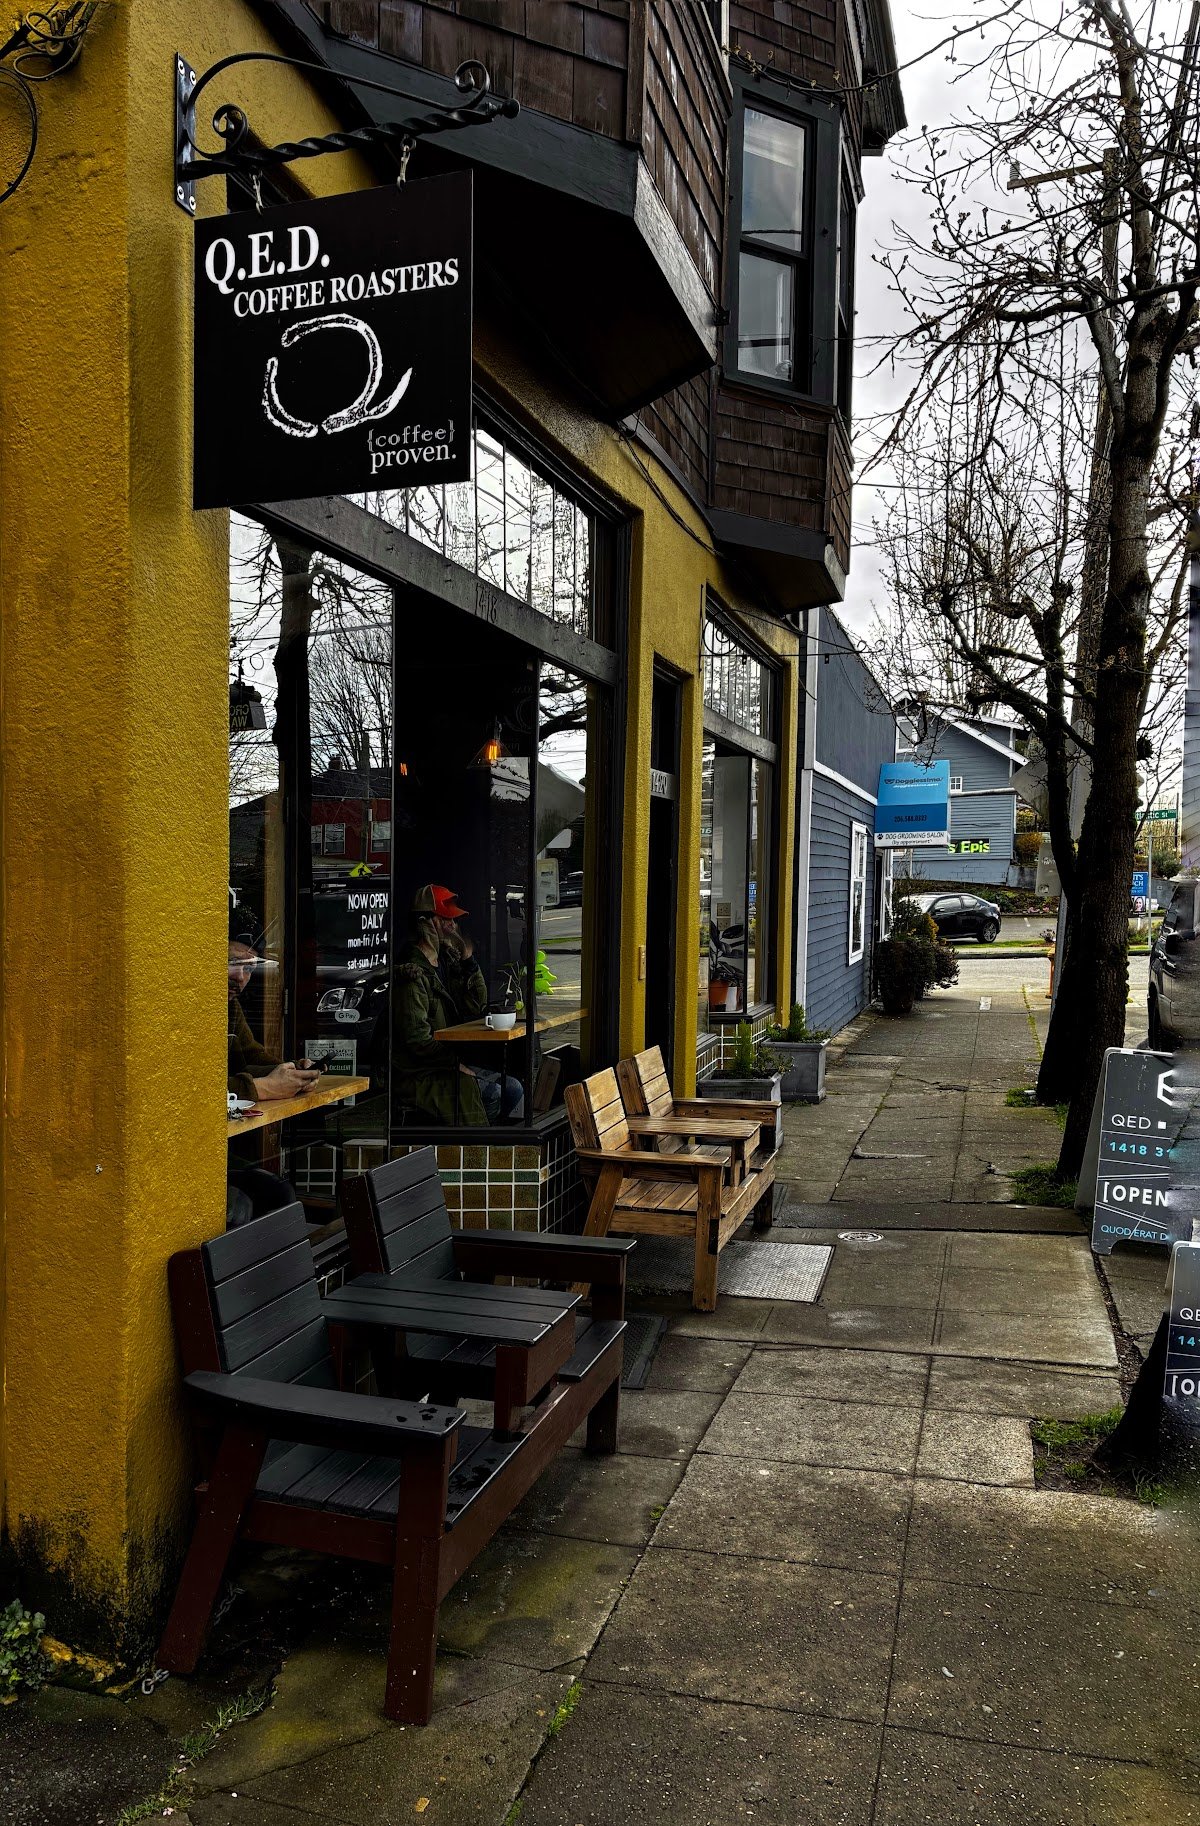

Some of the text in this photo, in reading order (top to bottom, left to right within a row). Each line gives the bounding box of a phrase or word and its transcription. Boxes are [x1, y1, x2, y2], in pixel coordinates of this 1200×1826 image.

[205, 225, 330, 295] Q.E.D.
[233, 258, 459, 317] COFFEE ROASTERS
[370, 444, 457, 475] proven.
[475, 583, 497, 623] 1418
[348, 893, 388, 910] NOW OPEN
[361, 913, 384, 930] DAILY
[347, 933, 371, 948] mon-fri
[347, 957, 369, 970] sat-sun
[345, 1012, 356, 1020] Pay
[1111, 1114, 1151, 1130] QED
[1109, 1141, 1171, 1157] 1418 3
[1101, 1224, 1132, 1237] QUOD
[1133, 1228, 1157, 1240] ERAT
[1178, 1335, 1200, 1346] 14
